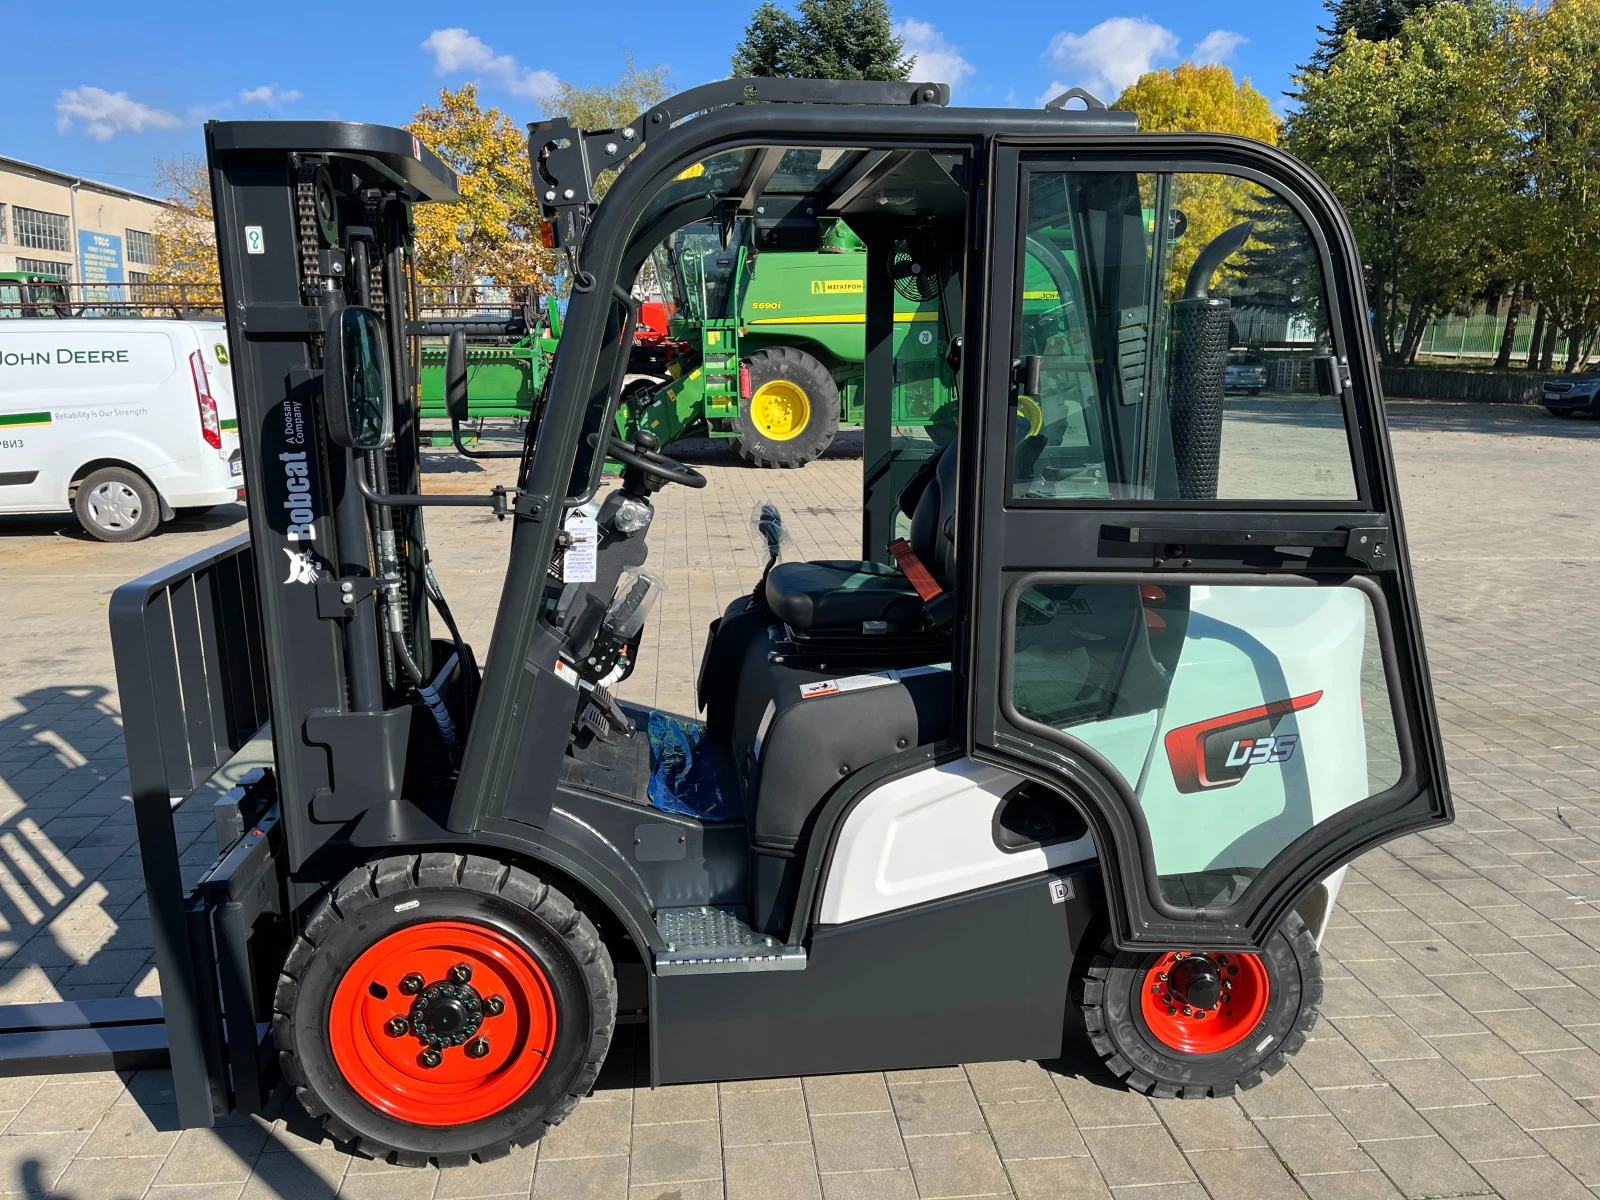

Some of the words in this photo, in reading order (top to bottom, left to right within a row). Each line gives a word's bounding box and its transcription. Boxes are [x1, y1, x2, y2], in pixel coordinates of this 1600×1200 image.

[57, 349, 130, 364] DEERE
[55, 411, 90, 420] Reliability
[99, 409, 113, 417] Our
[114, 407, 148, 417] Strength
[283, 400, 294, 435] Doosan
[293, 401, 305, 444] Company
[285, 437, 296, 445] A
[279, 451, 317, 541] Bobcat
